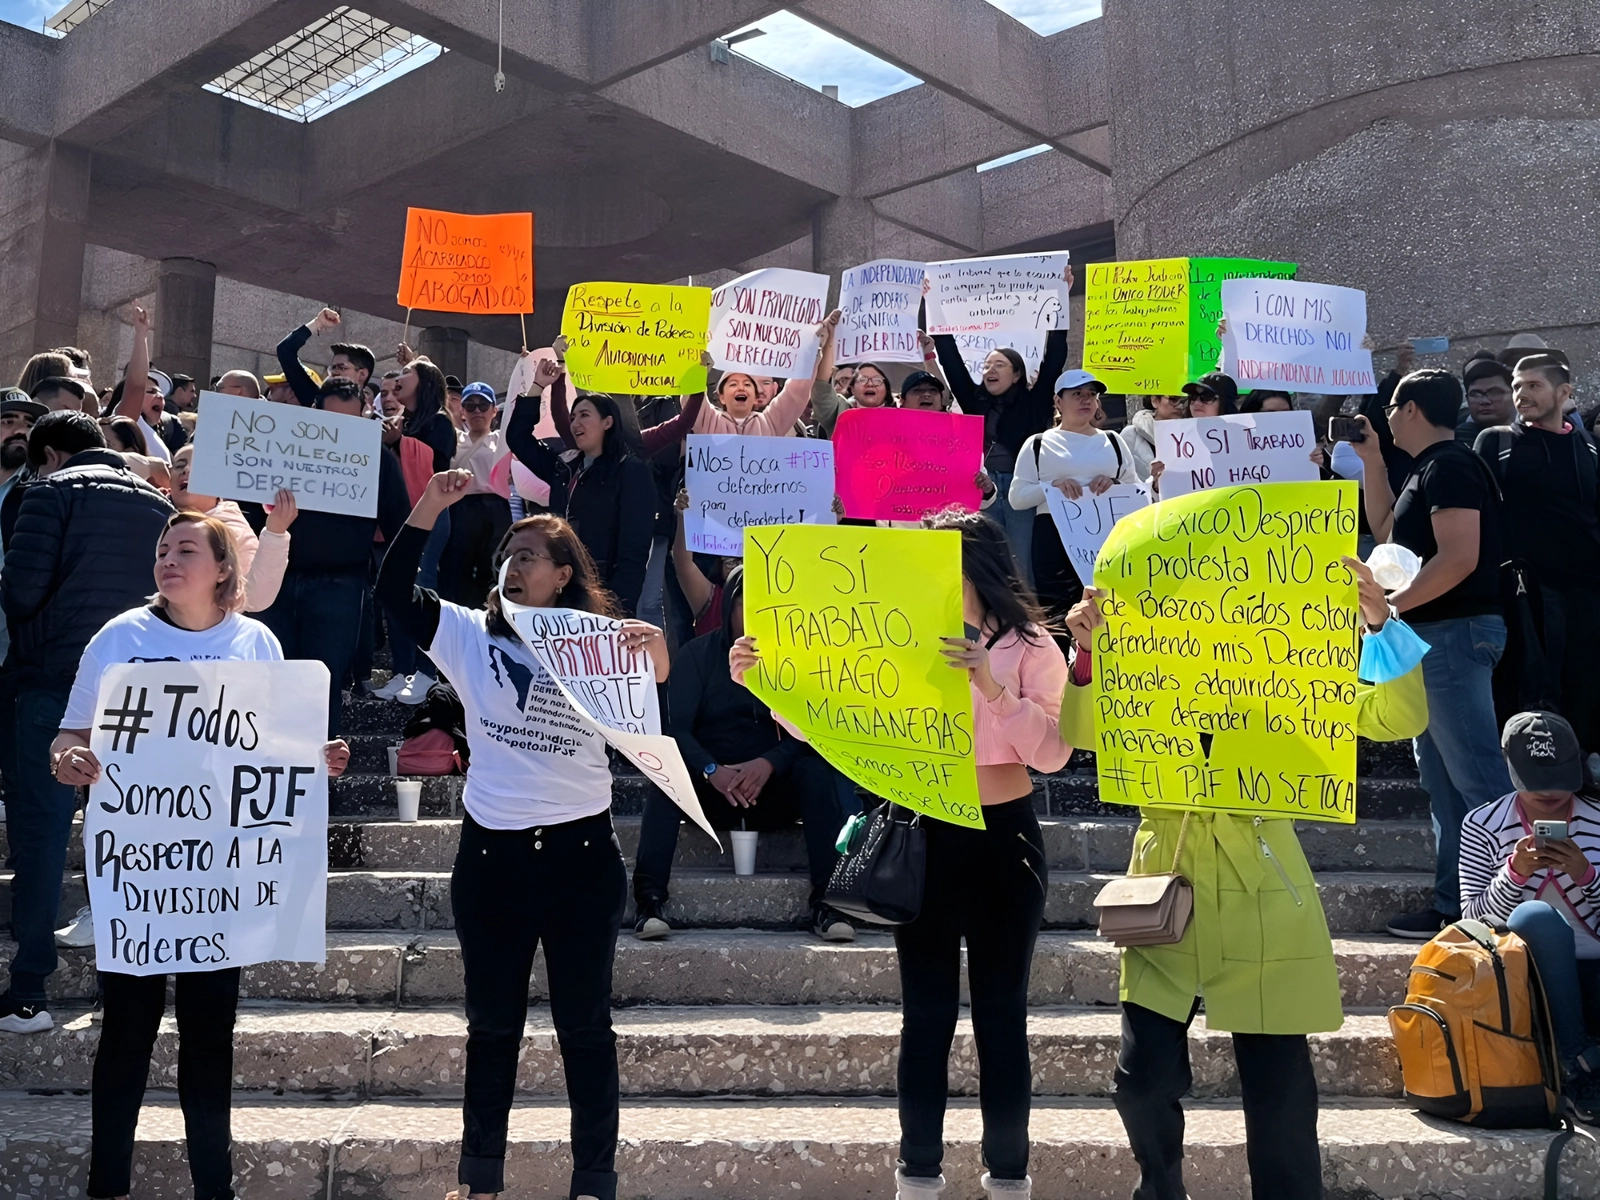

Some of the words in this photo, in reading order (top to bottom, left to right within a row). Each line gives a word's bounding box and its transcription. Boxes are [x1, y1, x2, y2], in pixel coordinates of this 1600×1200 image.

[417, 215, 448, 246] NO
[843, 272, 855, 292] LA
[860, 264, 926, 286] INDEPENDENCIA
[938, 271, 951, 280] un
[958, 267, 992, 278] tribunal
[997, 270, 1011, 278] que
[941, 284, 950, 293] lo
[990, 284, 997, 295] y
[1010, 281, 1045, 293] proteja
[415, 279, 526, 310] ABOGADOS
[571, 285, 641, 313] Respeto
[650, 302, 661, 313] a
[730, 286, 757, 315] SON
[758, 290, 822, 325] PRIVILEGIOS
[853, 295, 864, 315] DE
[871, 291, 909, 310] PODERES
[1147, 284, 1188, 300] PODER
[1197, 286, 1211, 299] de
[851, 311, 900, 331] SIGNIFICA
[1303, 298, 1332, 323] MIS
[575, 311, 631, 333] División
[636, 320, 650, 337] de
[655, 318, 695, 340] Poderes
[697, 332, 706, 345] y
[726, 318, 752, 341] SON
[753, 322, 801, 349] NUESTROS
[955, 334, 998, 350] ESPETO
[1103, 321, 1147, 332] personas
[1245, 322, 1315, 346] DERECHOS
[1237, 359, 1325, 384] INDEPENDENCIA
[1331, 370, 1374, 387] JUDICIAL
[231, 410, 276, 434] NO
[291, 421, 339, 444] SON
[1206, 429, 1230, 454] SI
[226, 433, 371, 466] PRIVILEGIOS
[740, 445, 780, 475] toca
[784, 450, 830, 469] #PJF
[283, 460, 359, 477] NUESTROS
[1191, 467, 1216, 490] NO
[1229, 464, 1271, 483] HAGO
[236, 471, 368, 502] DERECHOS!
[717, 476, 807, 495] defendernos
[700, 500, 726, 518] para
[1229, 488, 1356, 550] Despierta
[1147, 542, 1250, 588] protesta
[1267, 543, 1314, 584] NO
[1325, 561, 1353, 586] es
[756, 601, 919, 652] TRABAJO,
[1101, 588, 1127, 617] de
[1135, 589, 1215, 620] Brazos
[1220, 586, 1290, 626] Caídos
[1302, 595, 1357, 655] estoy
[1098, 622, 1201, 659] defendiendo
[1213, 635, 1253, 664] mis
[1256, 628, 1357, 672] Derechos
[758, 649, 797, 692] NO
[809, 654, 900, 700] HAGO
[1099, 655, 1181, 693] laborales
[1195, 668, 1307, 708] adquiridos,
[1309, 679, 1356, 715] para
[806, 697, 972, 756] MAÑANERAS
[1171, 697, 1252, 732] defender
[1265, 700, 1296, 735] los
[1301, 707, 1356, 751] tuyos
[906, 758, 959, 788] PJF
[100, 763, 211, 821] Somos
[230, 765, 315, 827] PJF
[1176, 764, 1224, 803] PJF
[1238, 766, 1271, 804] NO
[1279, 771, 1312, 810] SE
[1314, 773, 1354, 814] TOCA
[938, 793, 980, 821] toca
[227, 836, 240, 868] A
[256, 837, 282, 865] LA
[123, 881, 239, 915] DIVISION
[255, 881, 279, 907] DE
[110, 918, 230, 966] Poderes.
